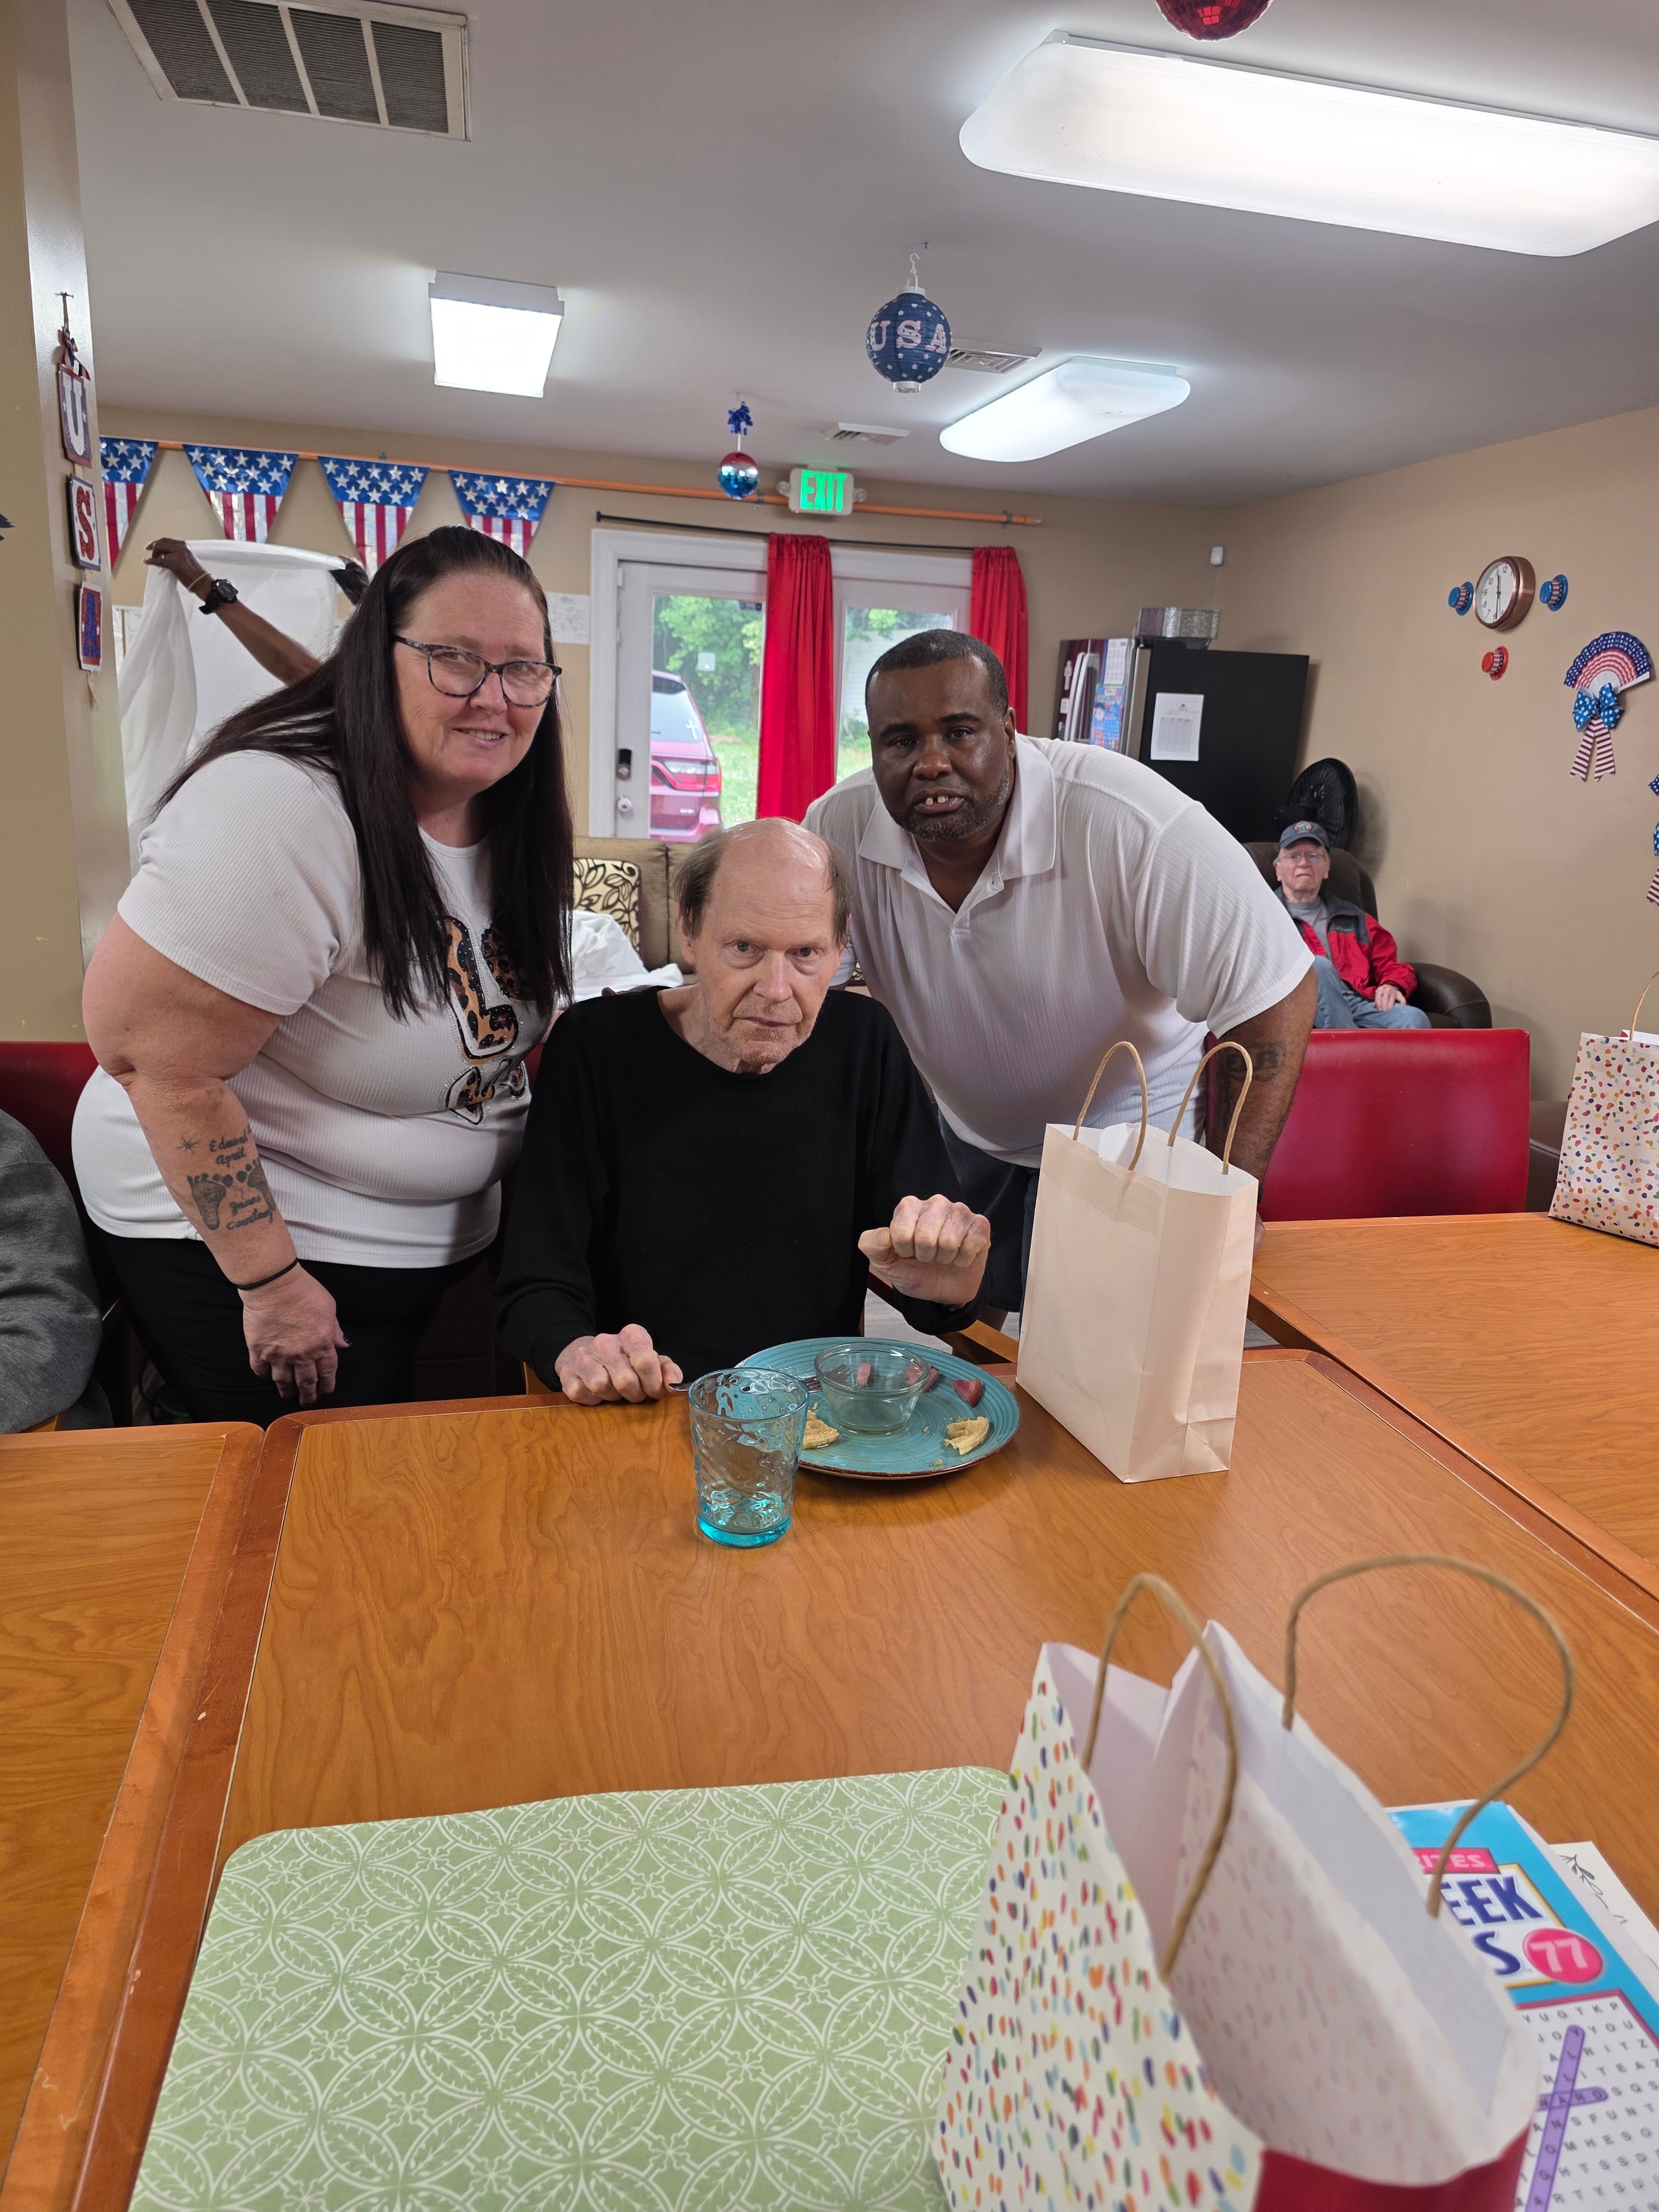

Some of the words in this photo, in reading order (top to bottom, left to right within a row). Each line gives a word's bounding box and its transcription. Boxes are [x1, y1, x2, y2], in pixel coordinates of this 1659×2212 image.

[870, 320, 948, 354] USA
[801, 470, 847, 512] EXIT
[1486, 609, 1490, 619] 7
[1529, 1937, 1588, 1972] 77
